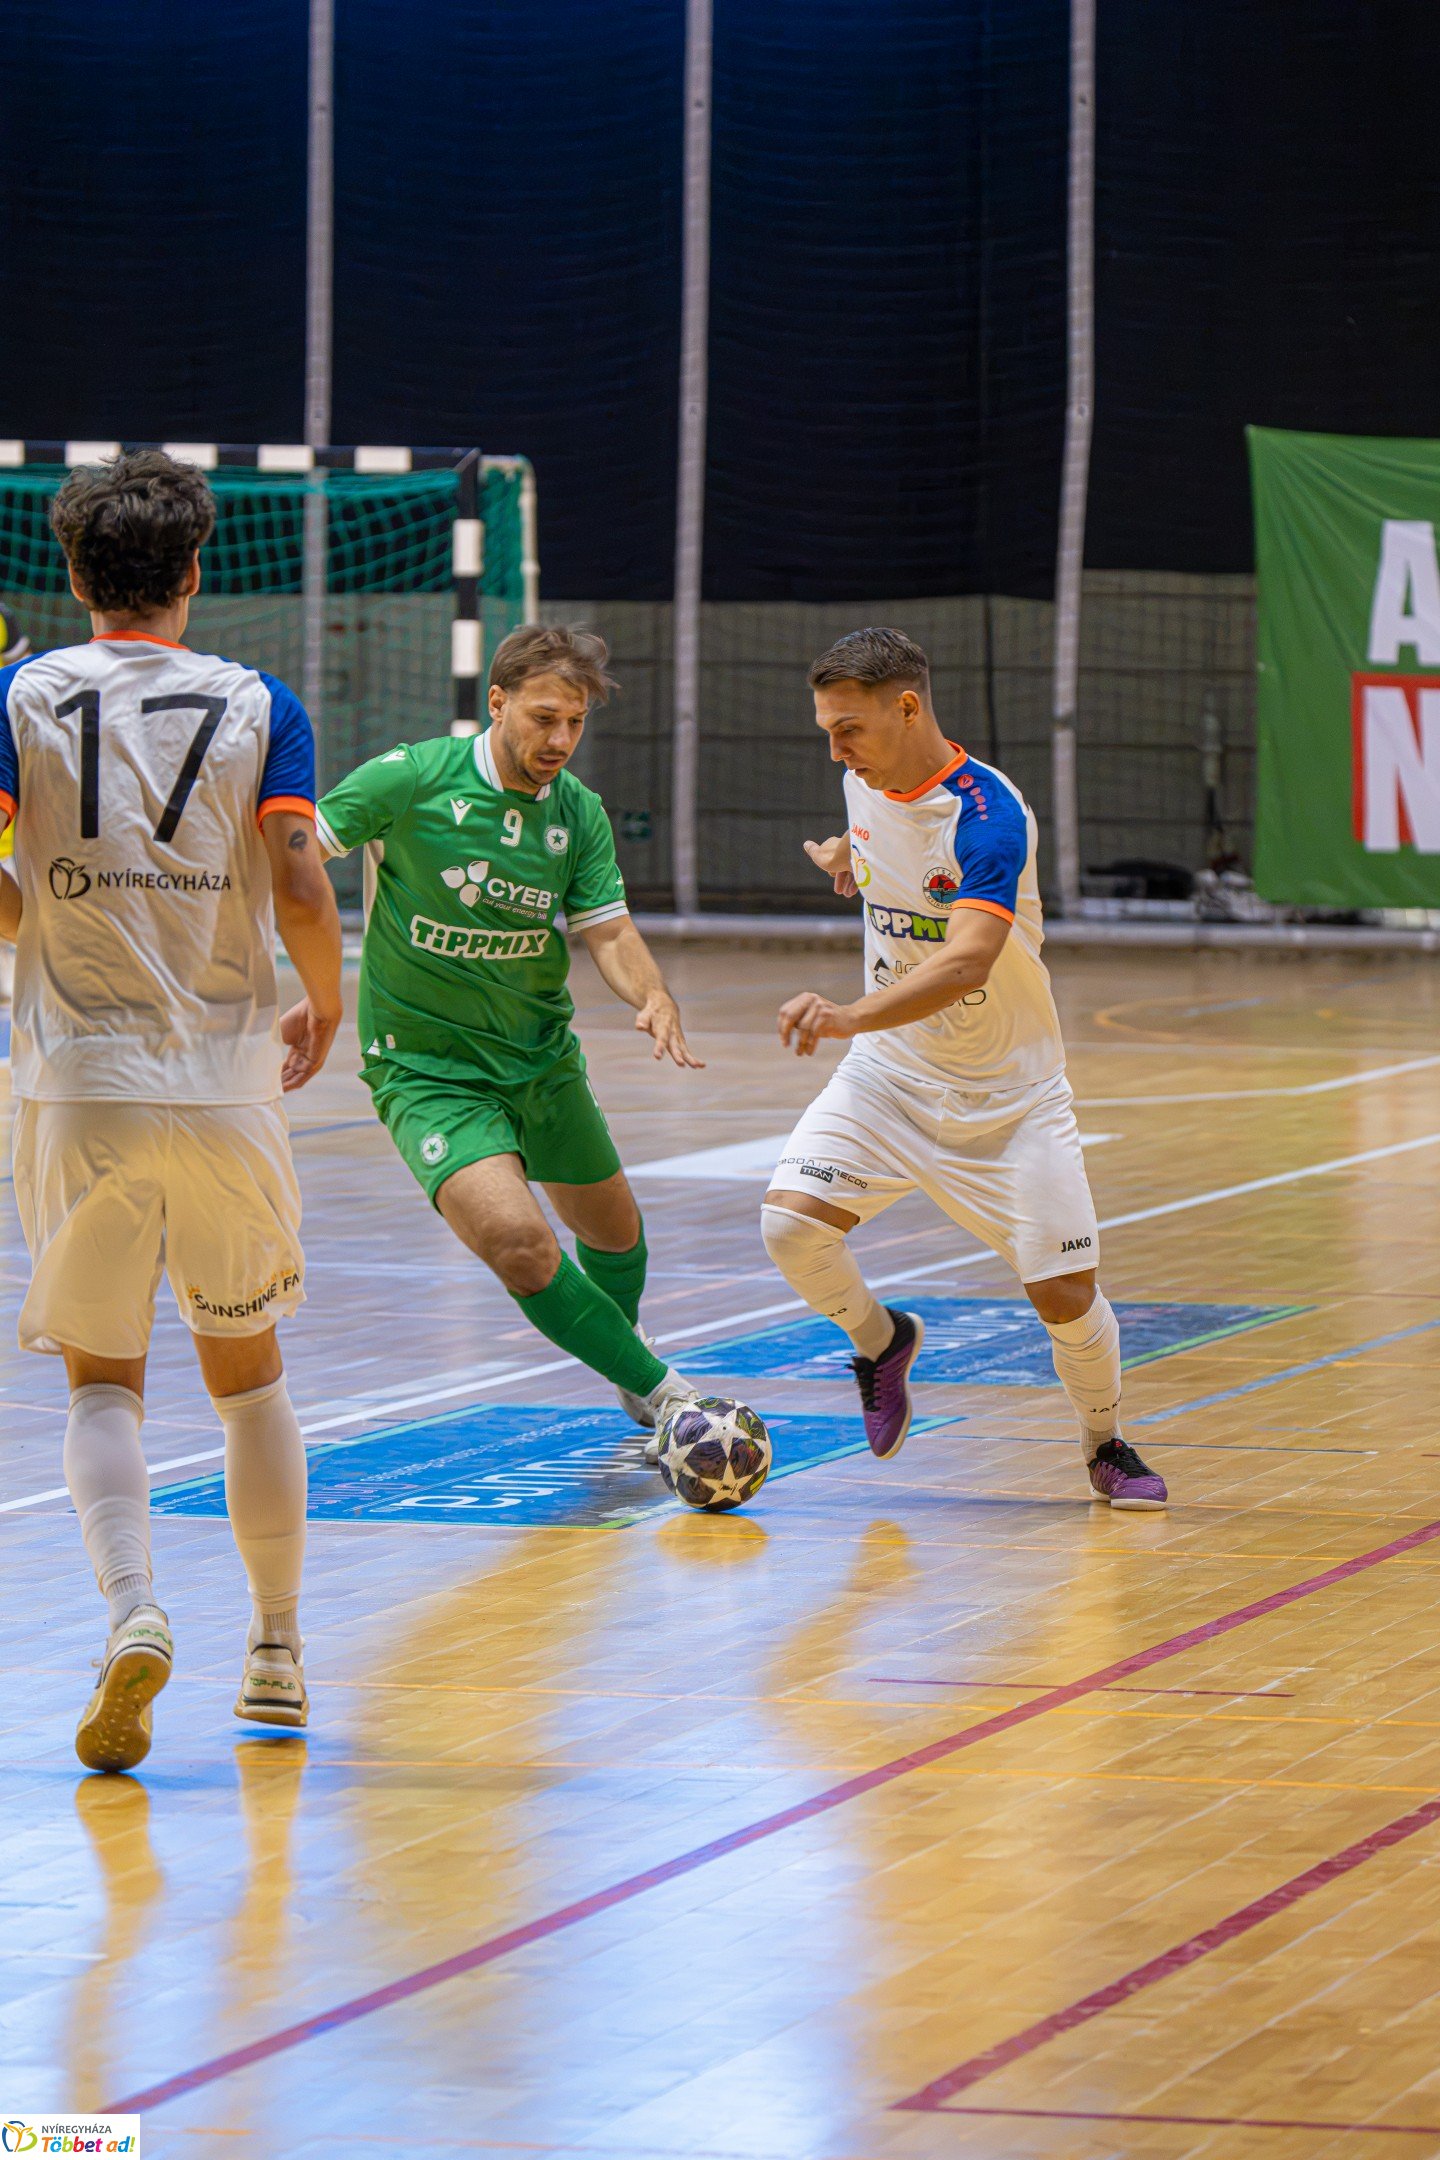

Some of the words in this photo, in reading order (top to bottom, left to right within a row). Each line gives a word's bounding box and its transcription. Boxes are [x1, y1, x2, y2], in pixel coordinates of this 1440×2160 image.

[55, 690, 227, 842] 17
[500, 808, 523, 847] 9
[97, 868, 231, 891] NYÍREGYHÁZA
[1061, 1236, 1092, 1253] JAKO
[194, 1283, 278, 1318] SUNSHINE
